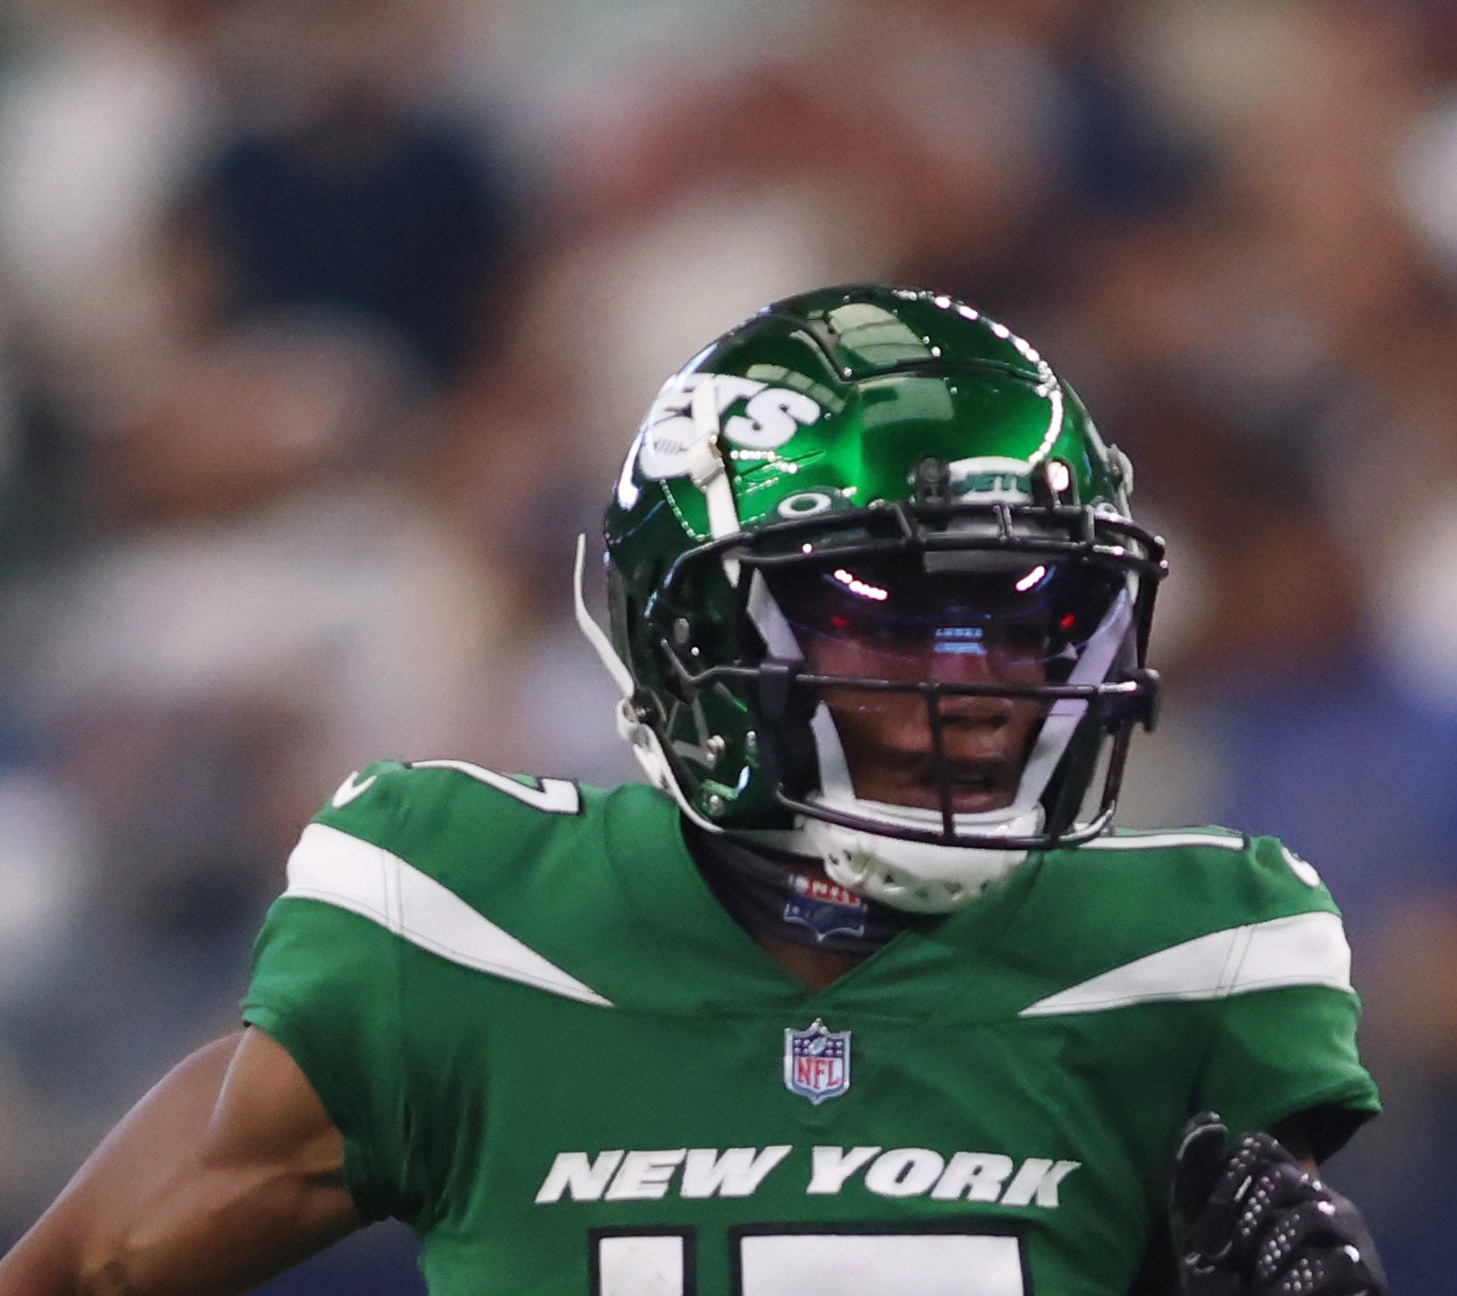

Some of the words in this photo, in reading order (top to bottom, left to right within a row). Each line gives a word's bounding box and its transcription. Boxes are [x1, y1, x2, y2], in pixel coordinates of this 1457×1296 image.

[796, 1057, 842, 1090] NFL
[535, 1145, 793, 1204] NEW
[806, 1146, 1082, 1208] YORK
